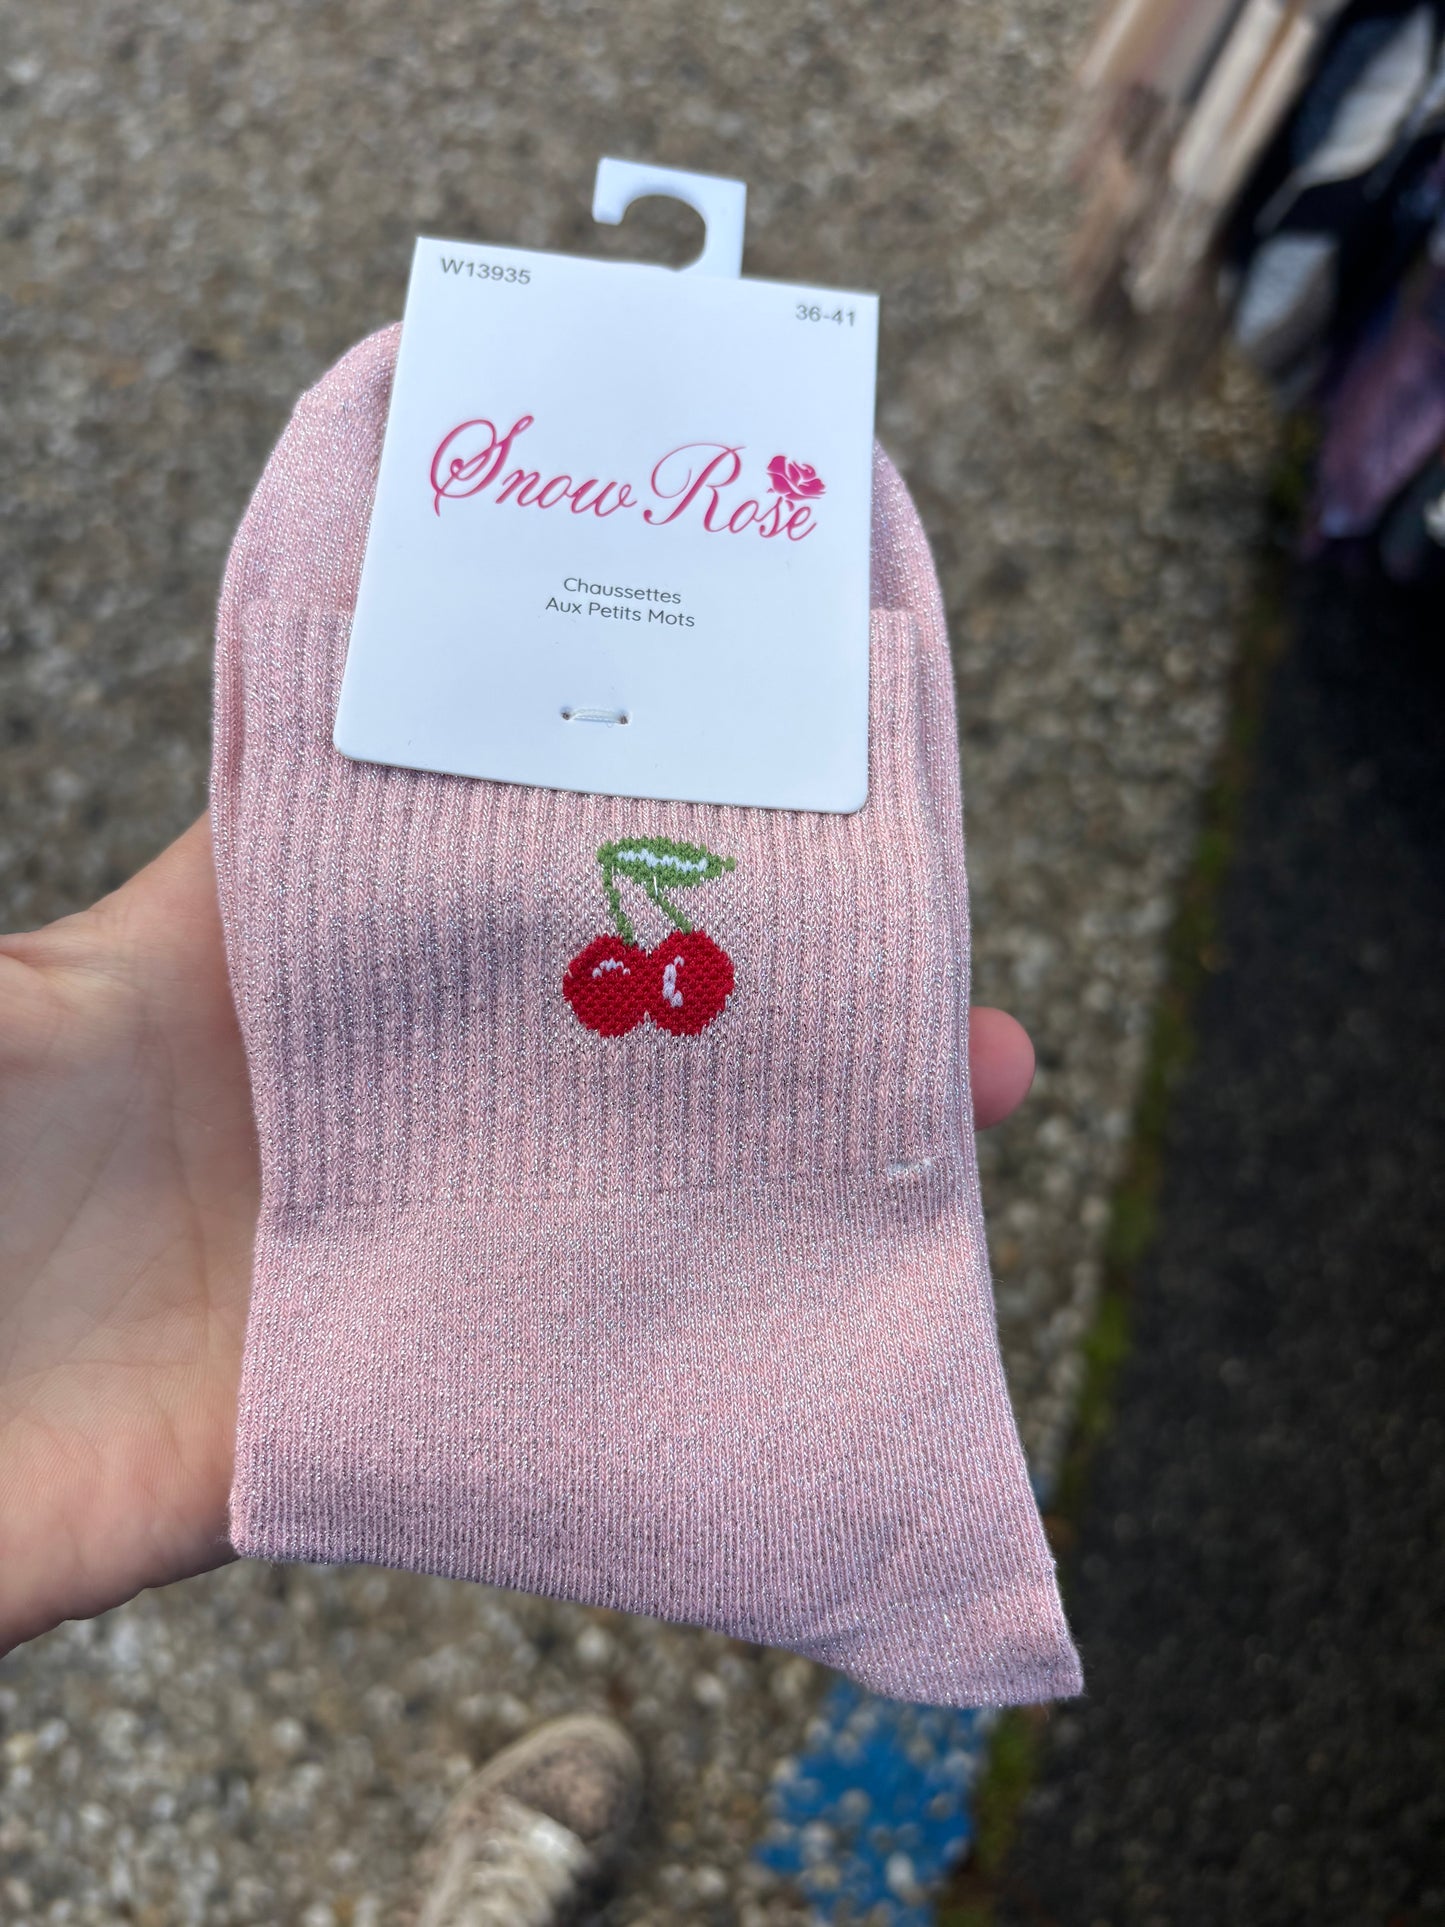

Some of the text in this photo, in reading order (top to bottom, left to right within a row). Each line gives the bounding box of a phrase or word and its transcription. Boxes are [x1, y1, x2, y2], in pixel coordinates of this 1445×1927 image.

[440, 257, 532, 285] W13935
[795, 303, 857, 328] 36-41
[430, 414, 818, 541] Snow Rose
[563, 577, 682, 605] Chaussettes
[545, 597, 695, 628] Aux Petits Mots
